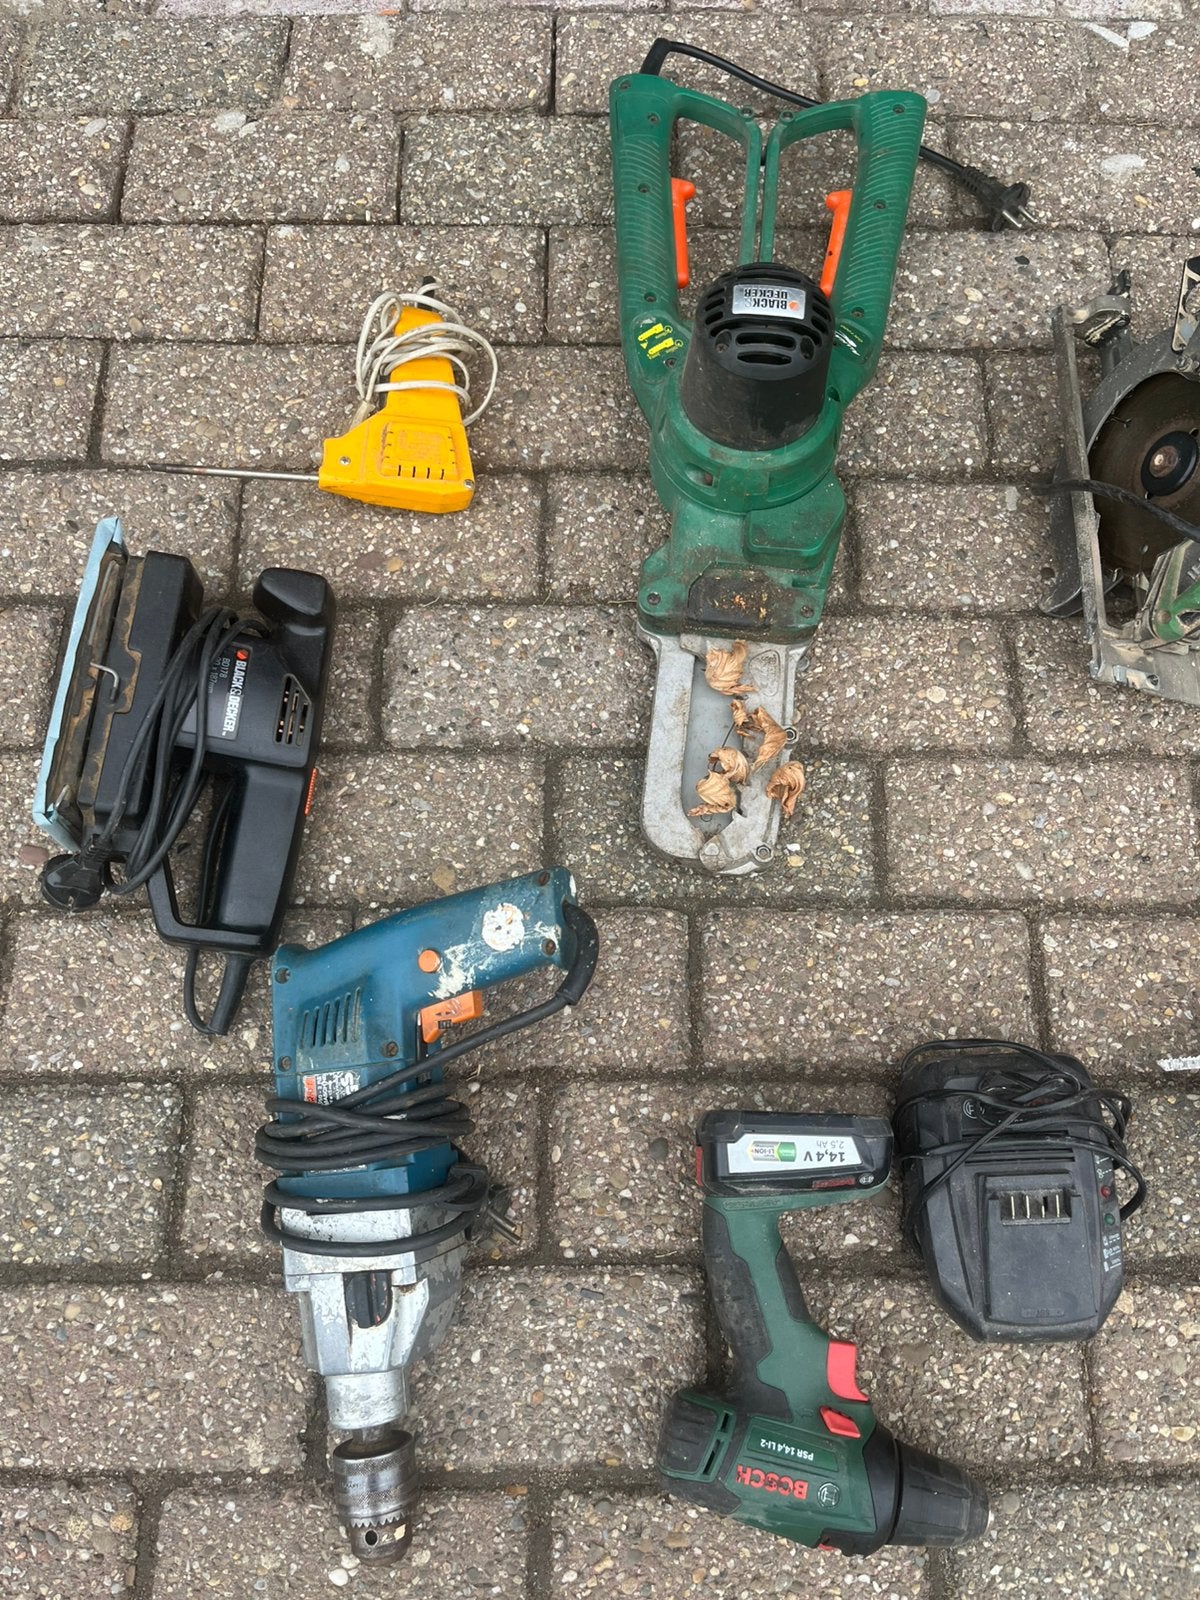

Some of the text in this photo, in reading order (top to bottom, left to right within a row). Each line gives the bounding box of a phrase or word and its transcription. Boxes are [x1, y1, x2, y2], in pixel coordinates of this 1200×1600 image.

[744, 288, 788, 299] DECKER
[816, 1140, 844, 1149] 2,5 Ah
[803, 1149, 846, 1162] 14,4 V
[760, 1438, 814, 1461] PSR 14,4 LI-2
[736, 1465, 809, 1500] BOSCH
